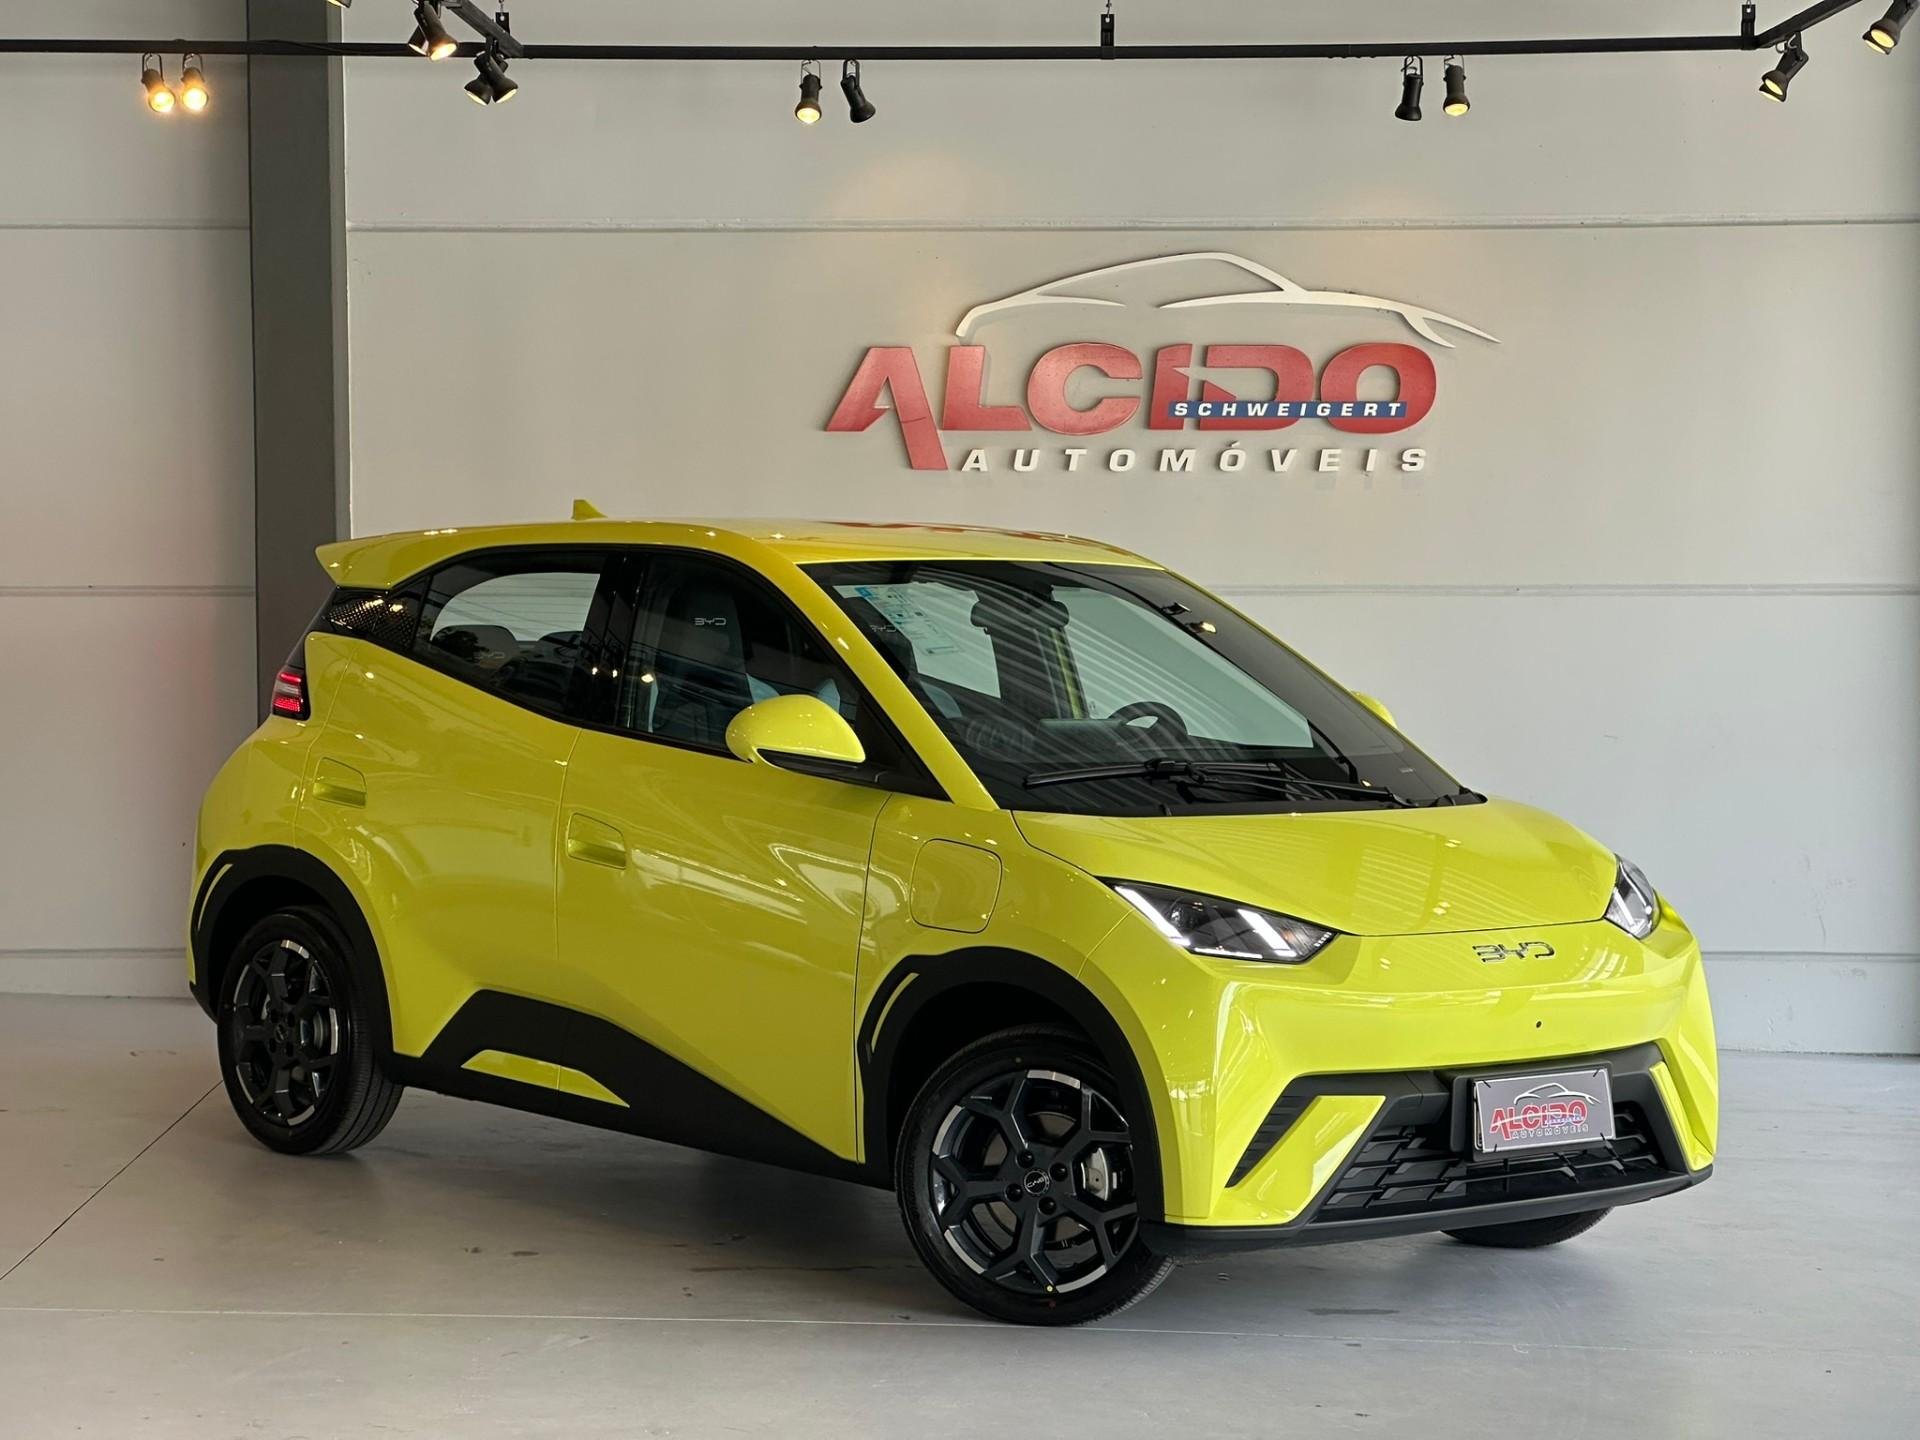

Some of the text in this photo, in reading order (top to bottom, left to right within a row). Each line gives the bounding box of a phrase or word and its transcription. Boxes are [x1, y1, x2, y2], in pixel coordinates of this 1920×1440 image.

[825, 342, 1437, 470] ALCIDO
[1174, 402, 1401, 417] SCHWEIGERT
[961, 441, 1428, 473] AUTOMÓVEIS
[694, 617, 727, 626] BYD
[1472, 941, 1555, 963] BYD
[1490, 1100, 1588, 1140] ALCIDO
